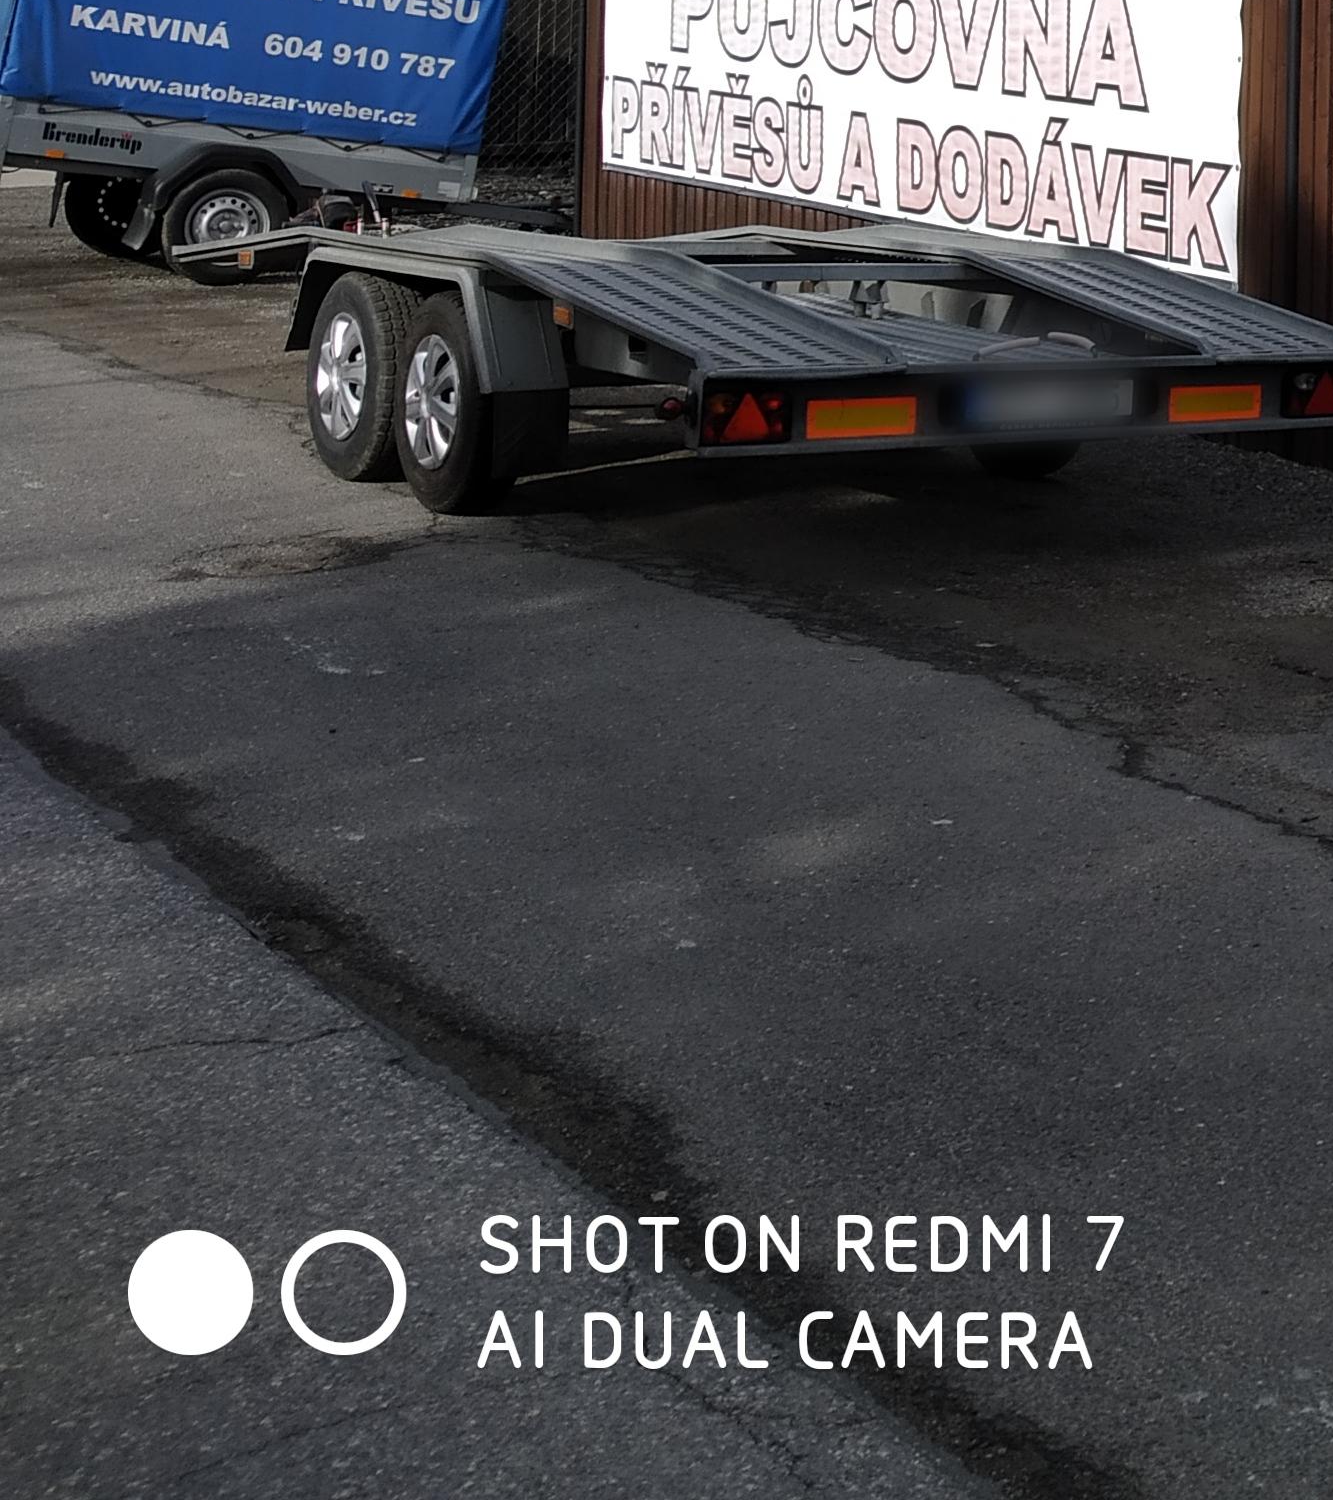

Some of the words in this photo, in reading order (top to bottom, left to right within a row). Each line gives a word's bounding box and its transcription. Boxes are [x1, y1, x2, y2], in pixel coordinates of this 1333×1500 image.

[70, 4, 230, 49] KARVINÁ
[264, 33, 323, 62] 604
[333, 42, 390, 71] 910
[400, 52, 456, 80] 787
[91, 71, 417, 128] www.autobazar-weber.cz
[611, 62, 823, 195] PŘÍVĚSŮ
[837, 111, 880, 207] A
[897, 117, 1233, 272] DODÁVEK
